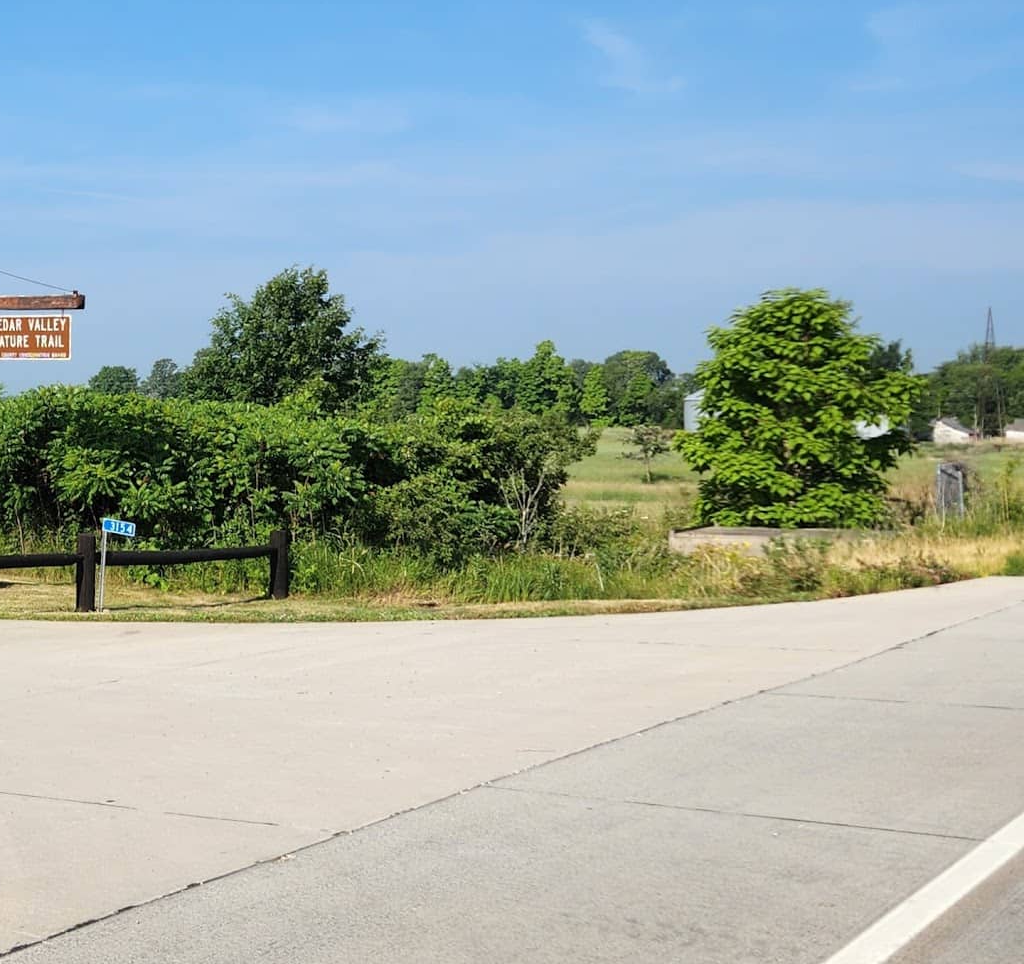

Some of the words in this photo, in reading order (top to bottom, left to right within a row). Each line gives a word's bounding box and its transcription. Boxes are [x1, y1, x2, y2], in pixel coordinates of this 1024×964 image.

[28, 318, 66, 332] VALLEY
[35, 335, 64, 348] TRAIL
[110, 521, 133, 534] 3154
